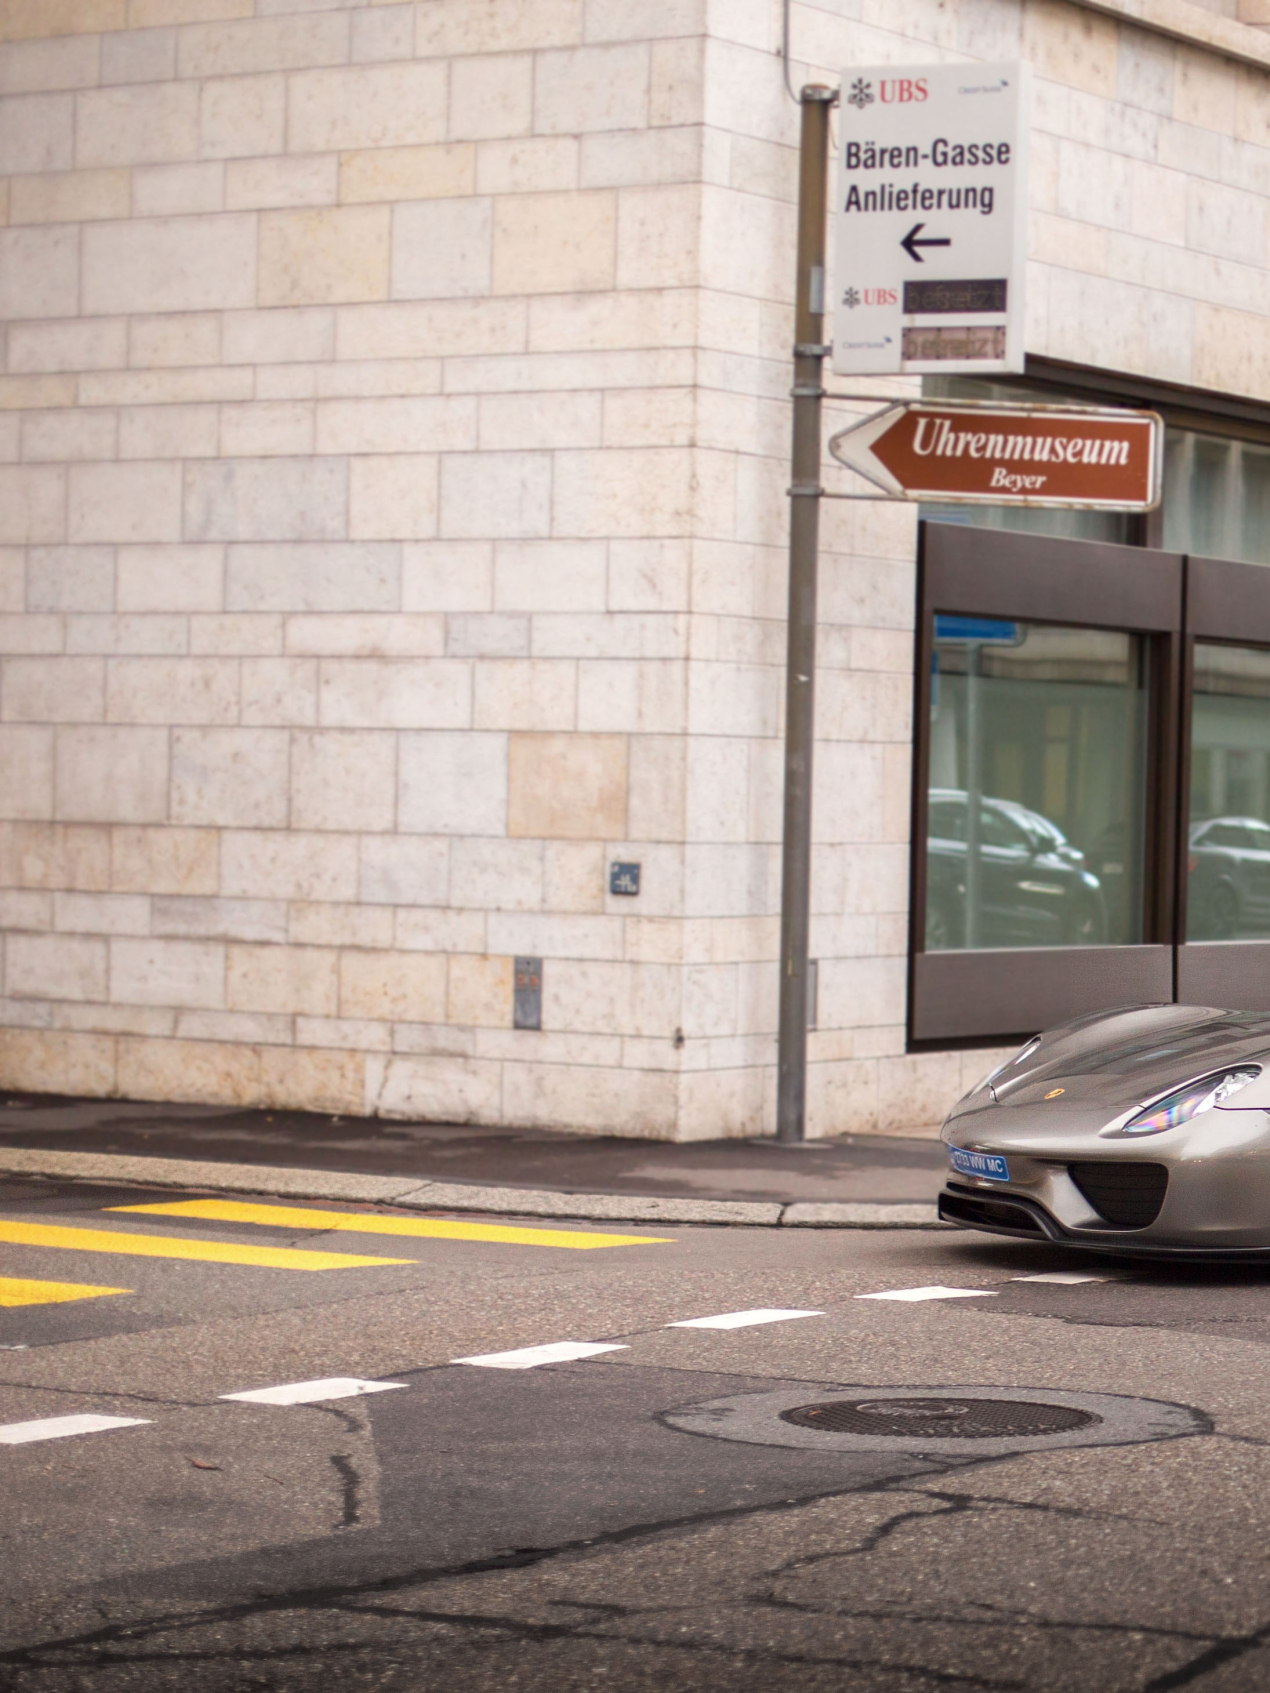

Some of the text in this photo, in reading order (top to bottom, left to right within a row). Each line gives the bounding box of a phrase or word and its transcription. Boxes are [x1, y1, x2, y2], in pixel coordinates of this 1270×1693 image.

[880, 79, 928, 103] UBS
[846, 138, 1011, 170] Bären-Gasse
[845, 182, 995, 215] Anlieferung
[863, 288, 898, 307] UBS
[912, 417, 1130, 466] Uhrenmuseum
[990, 467, 1047, 491] Beyer
[986, 1158, 1003, 1172] MC
